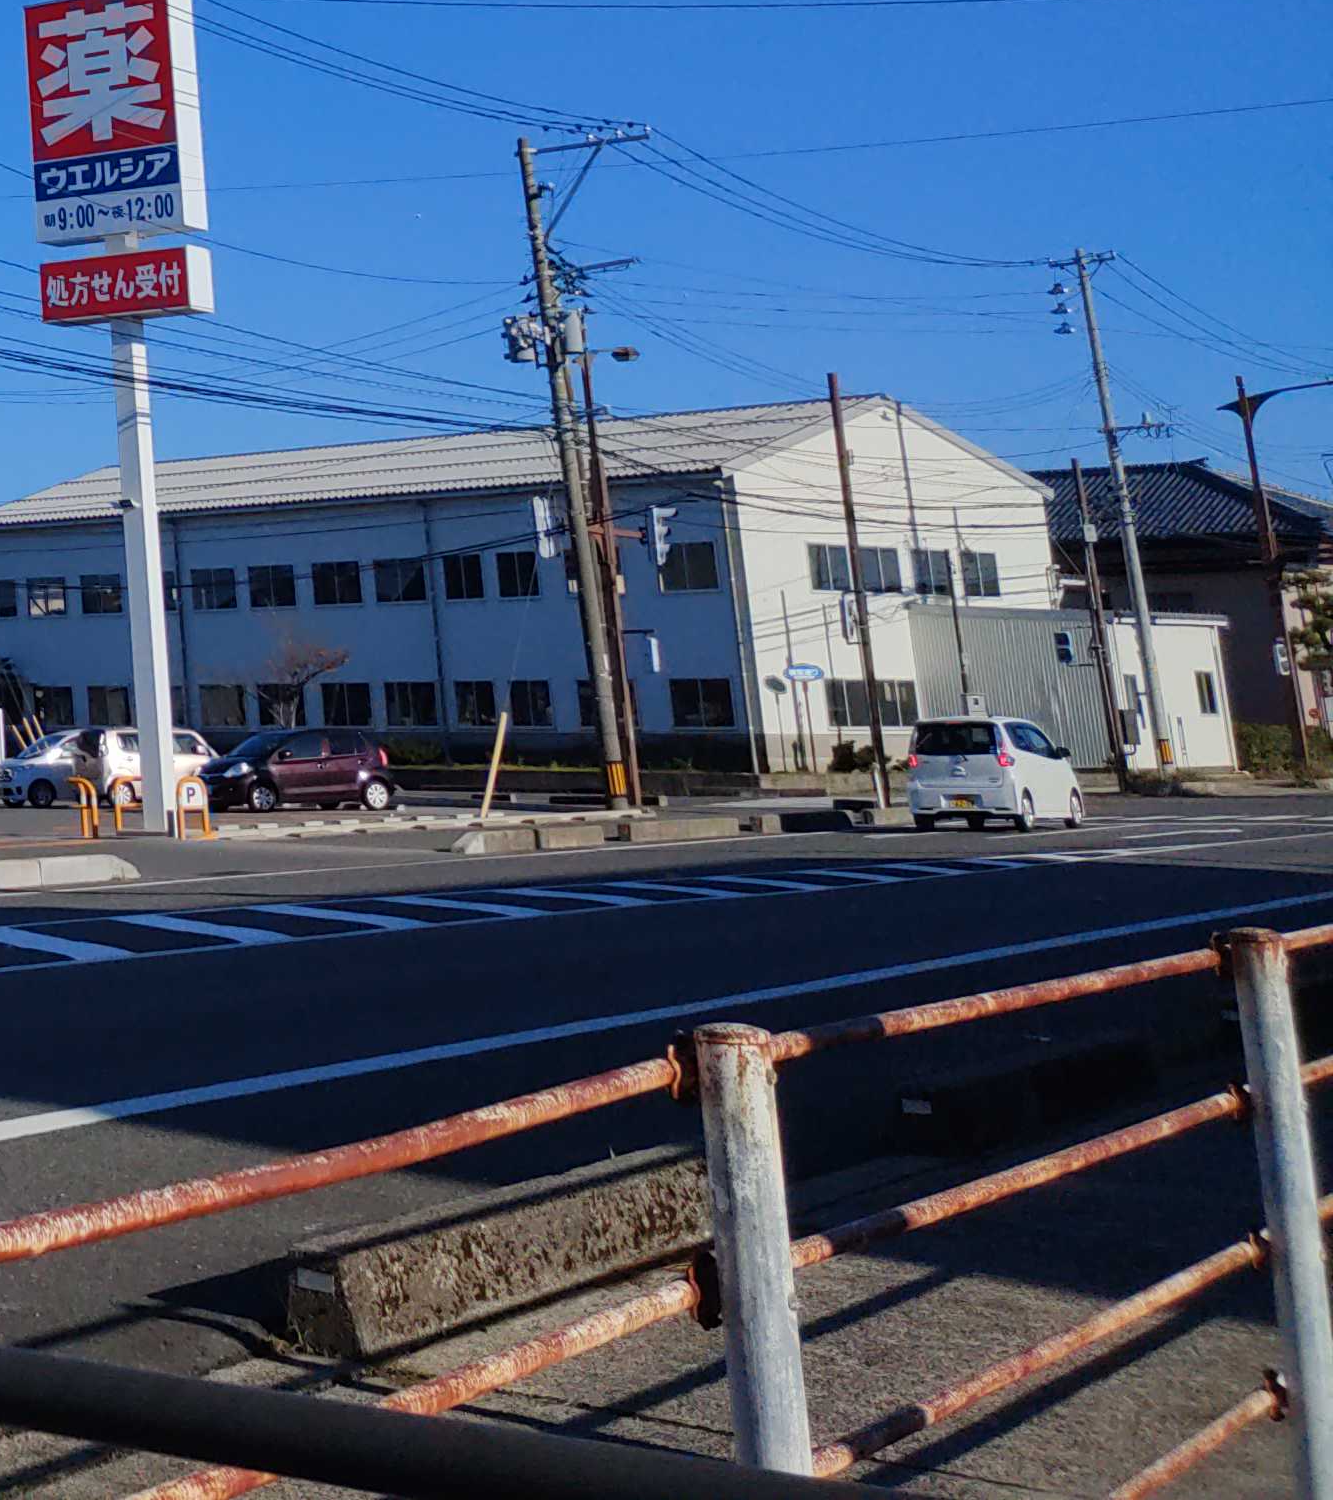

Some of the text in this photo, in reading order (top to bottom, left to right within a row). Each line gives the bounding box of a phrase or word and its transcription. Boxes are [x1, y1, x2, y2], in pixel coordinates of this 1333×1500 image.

[36, 1, 166, 147] 薬
[40, 152, 171, 195] ウエルシア
[46, 261, 182, 308] 処方せん受付
[186, 786, 196, 803] P
